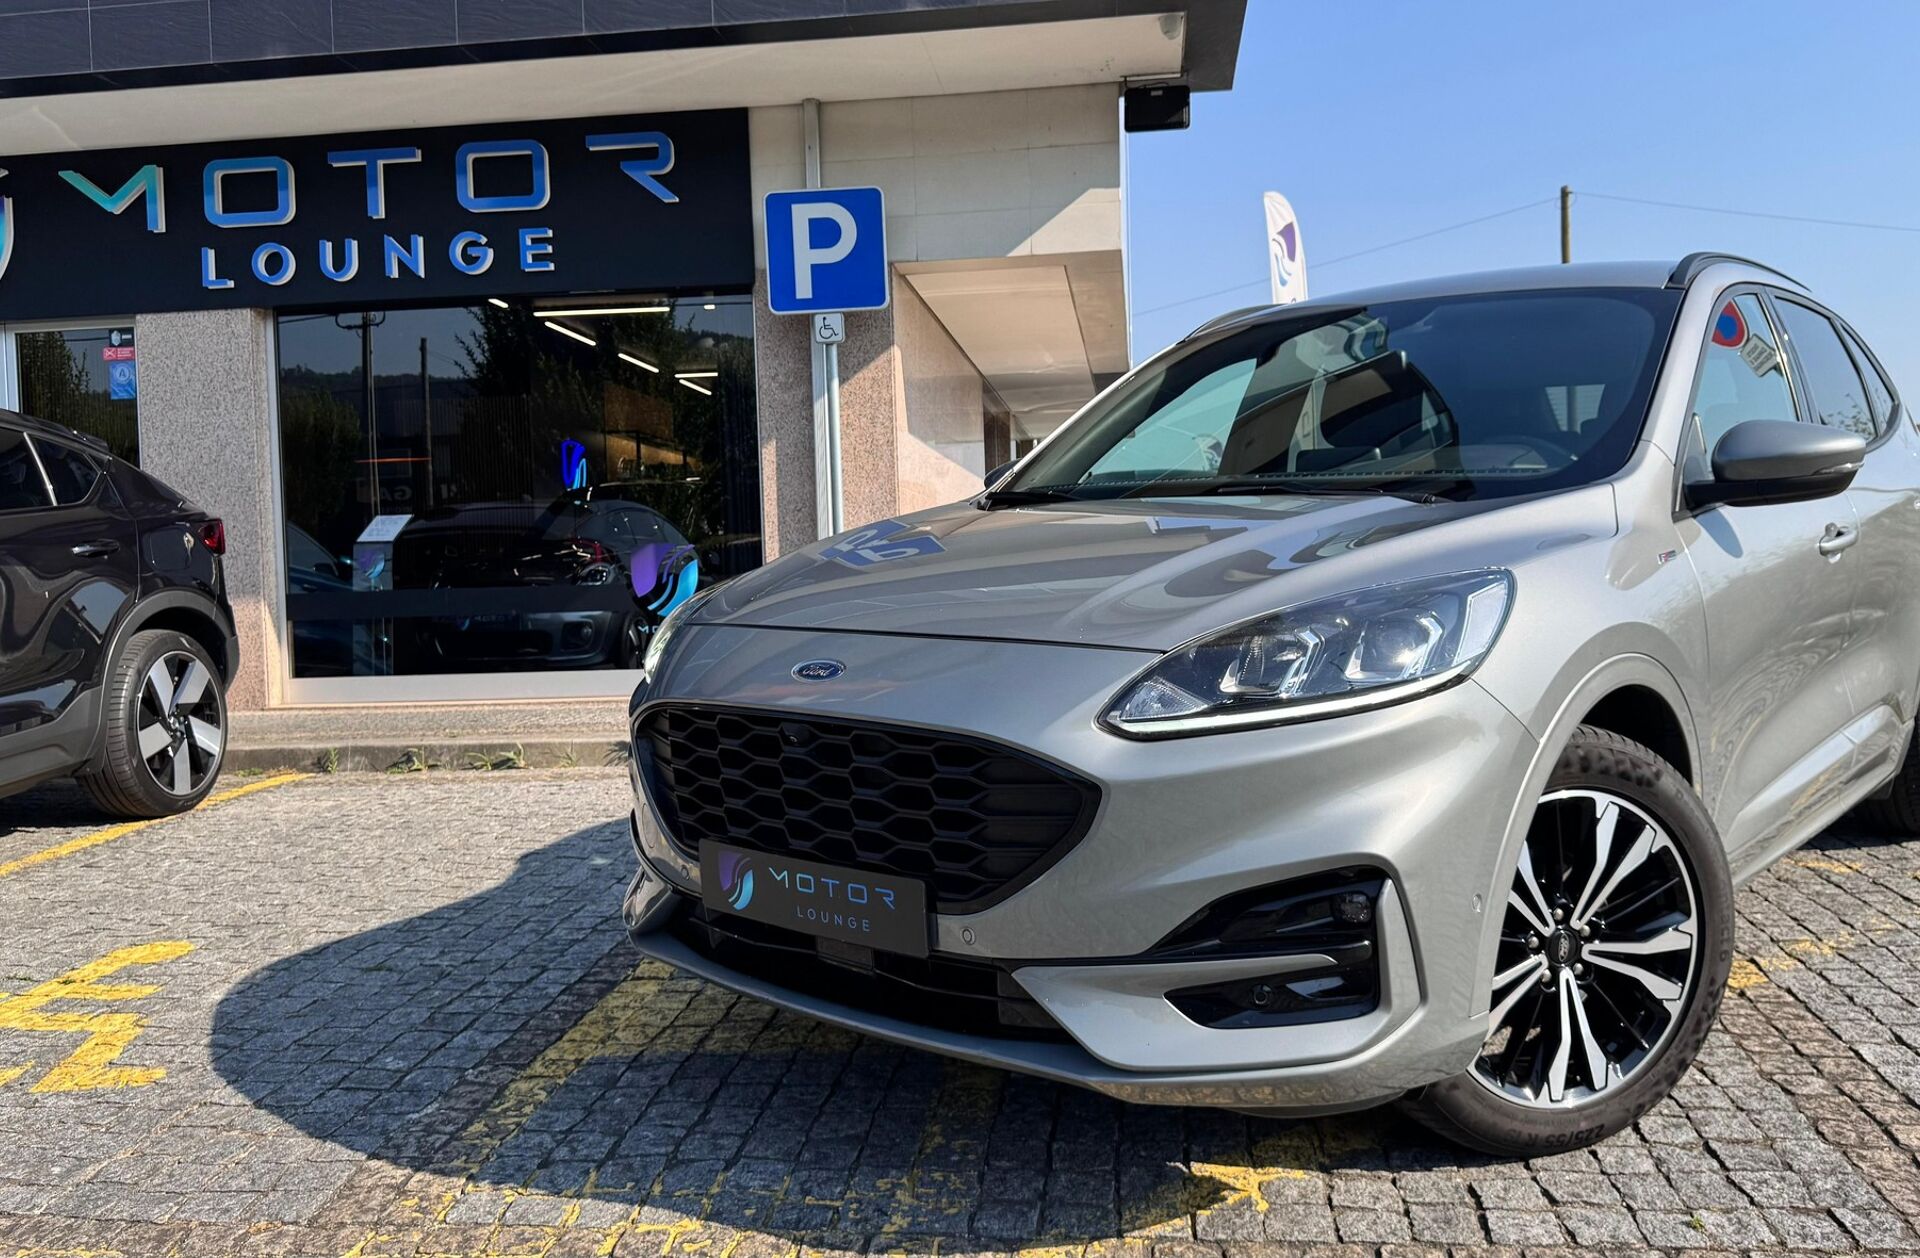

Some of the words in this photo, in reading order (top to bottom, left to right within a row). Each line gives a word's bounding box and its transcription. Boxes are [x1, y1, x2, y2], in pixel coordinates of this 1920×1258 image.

[58, 131, 679, 233] MOTOR
[202, 227, 555, 290] LOUNGE
[791, 202, 857, 299] P
[768, 867, 895, 910] MOTOR
[796, 906, 870, 932] LOUNGE
